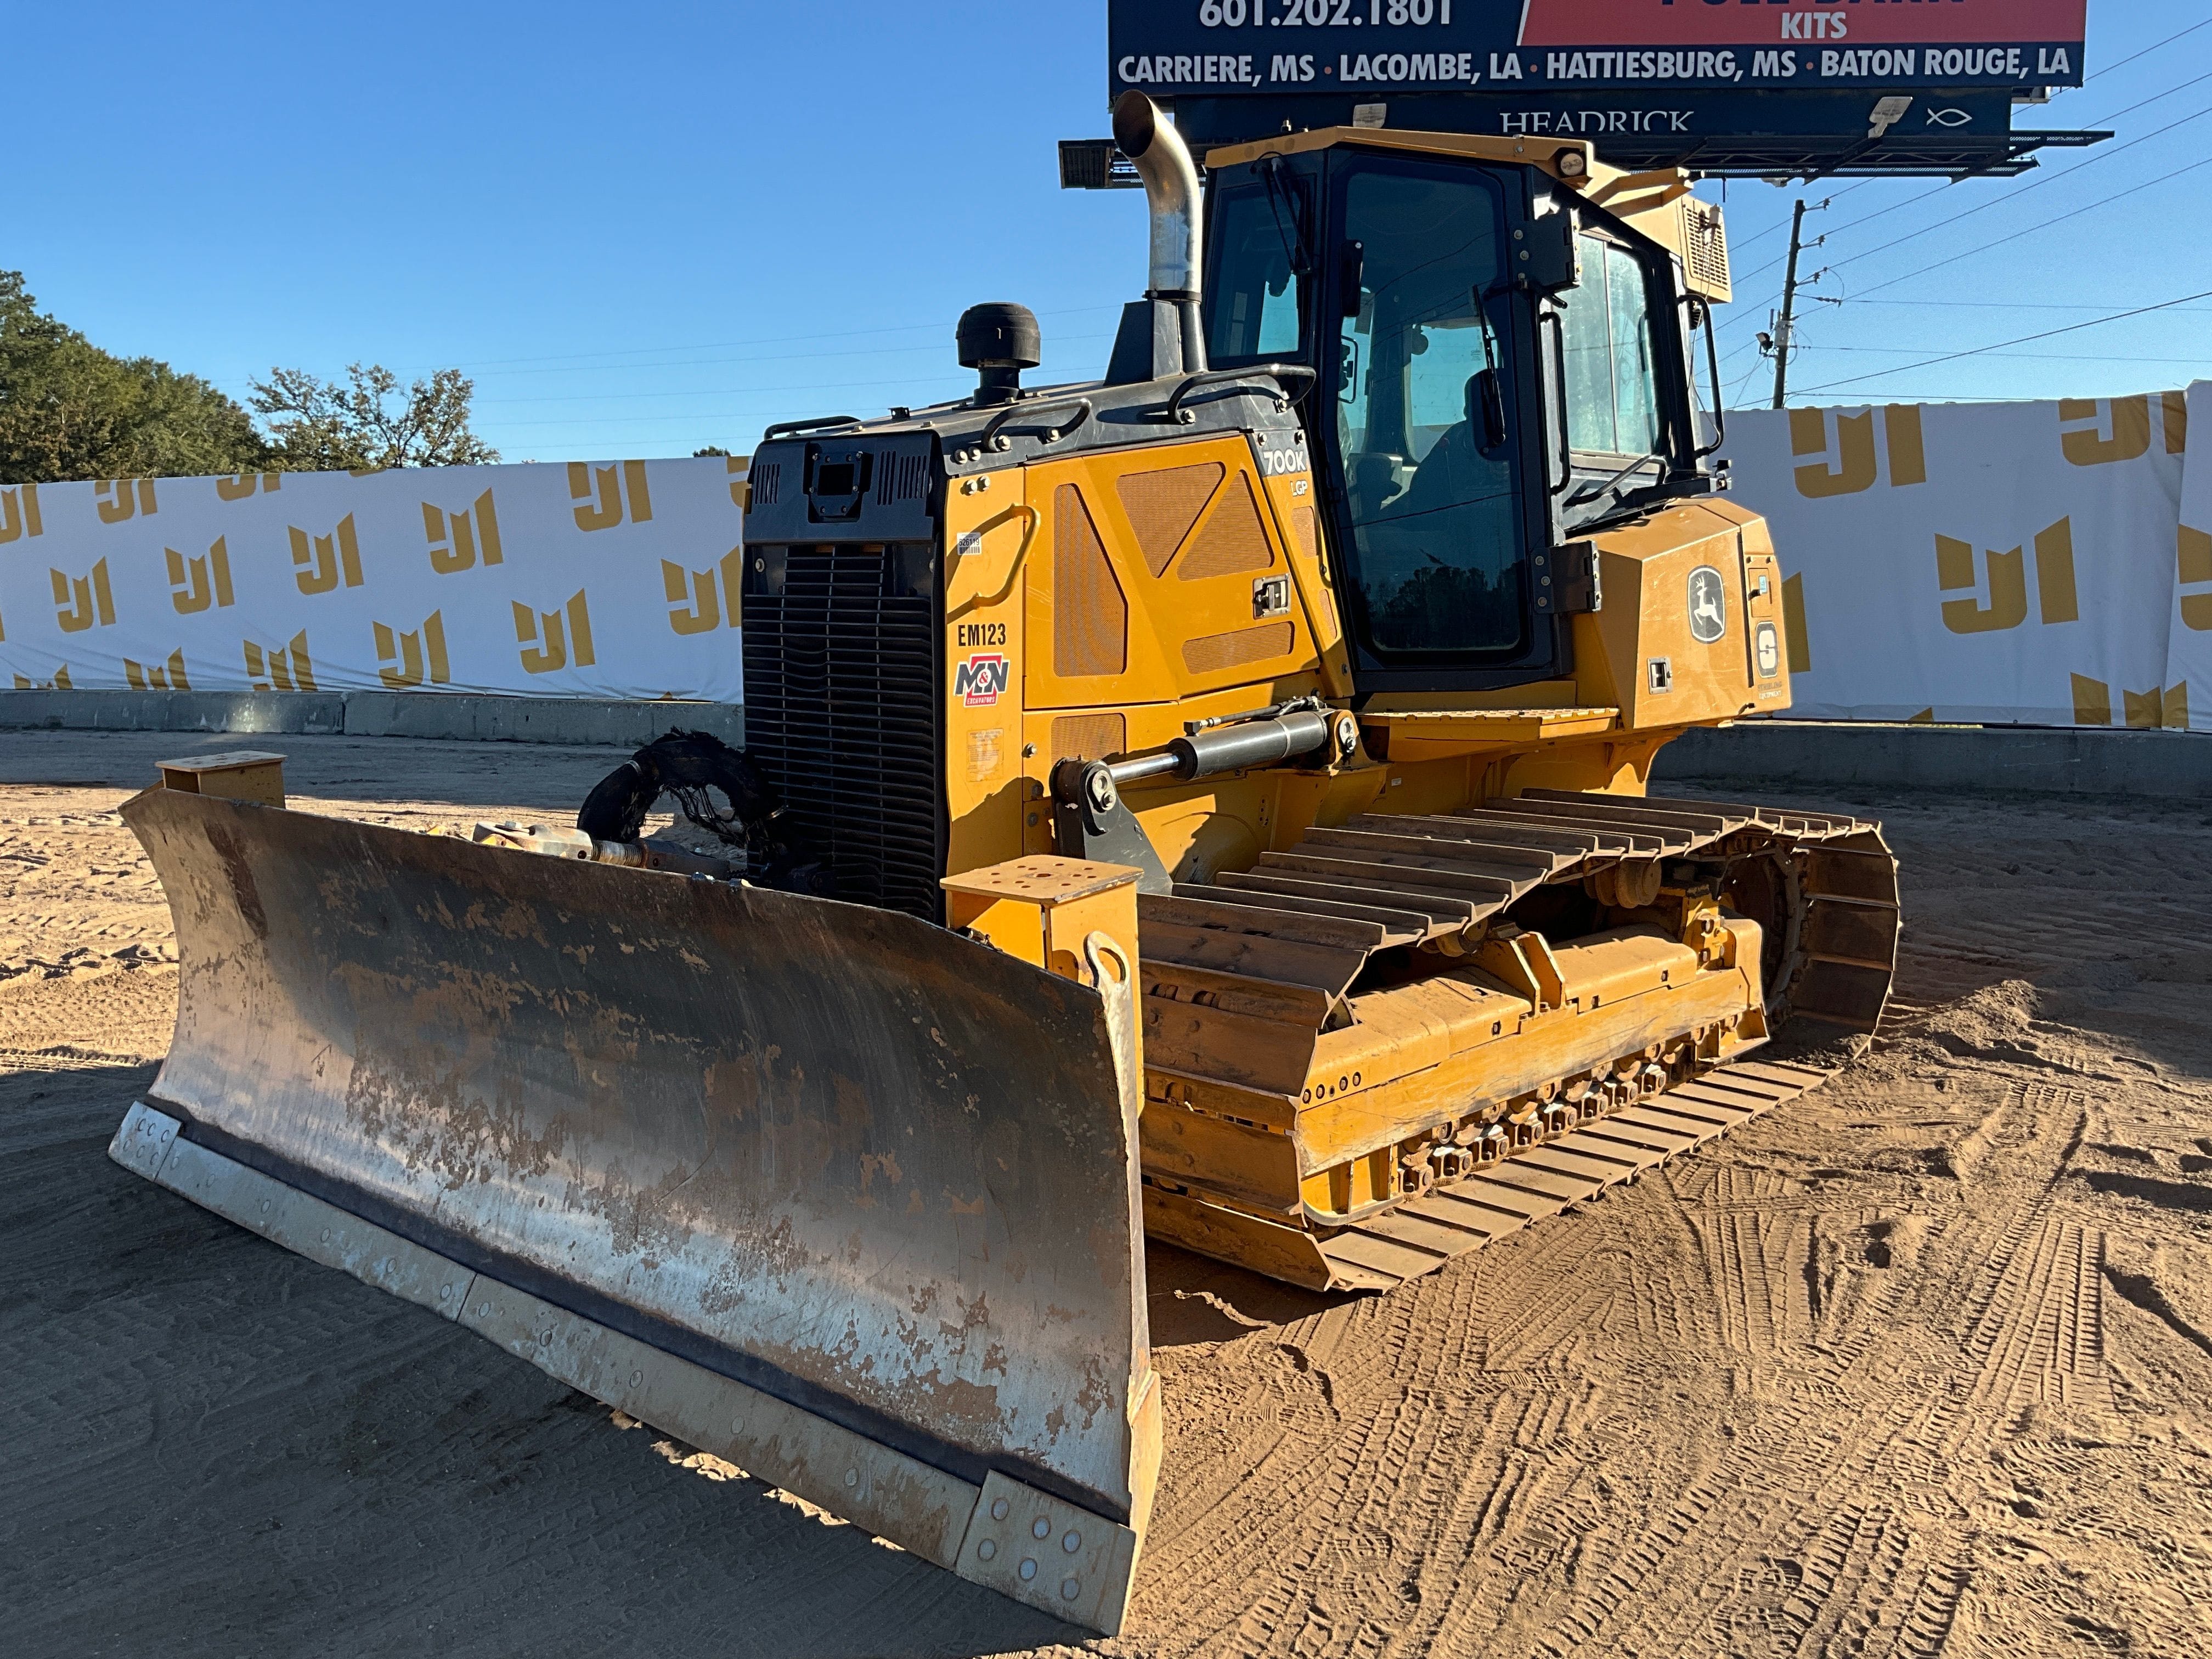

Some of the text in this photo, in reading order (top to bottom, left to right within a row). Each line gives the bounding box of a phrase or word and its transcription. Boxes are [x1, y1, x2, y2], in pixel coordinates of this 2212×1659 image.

[1200, 0, 1450, 27] 601.202.1801
[1781, 12, 1847, 38] KITS
[1118, 48, 2070, 87] CARRIERE, MS LACOMBE, LA HATTIESBURG, MS BATON ROUGE, LA
[1500, 110, 1695, 132] HEADRICK
[1263, 448, 1307, 475] 700K
[1290, 479, 1308, 496] LGP
[958, 623, 1006, 646] EM123
[955, 662, 1009, 695] M&N
[967, 697, 995, 705] EXCAVATORS
